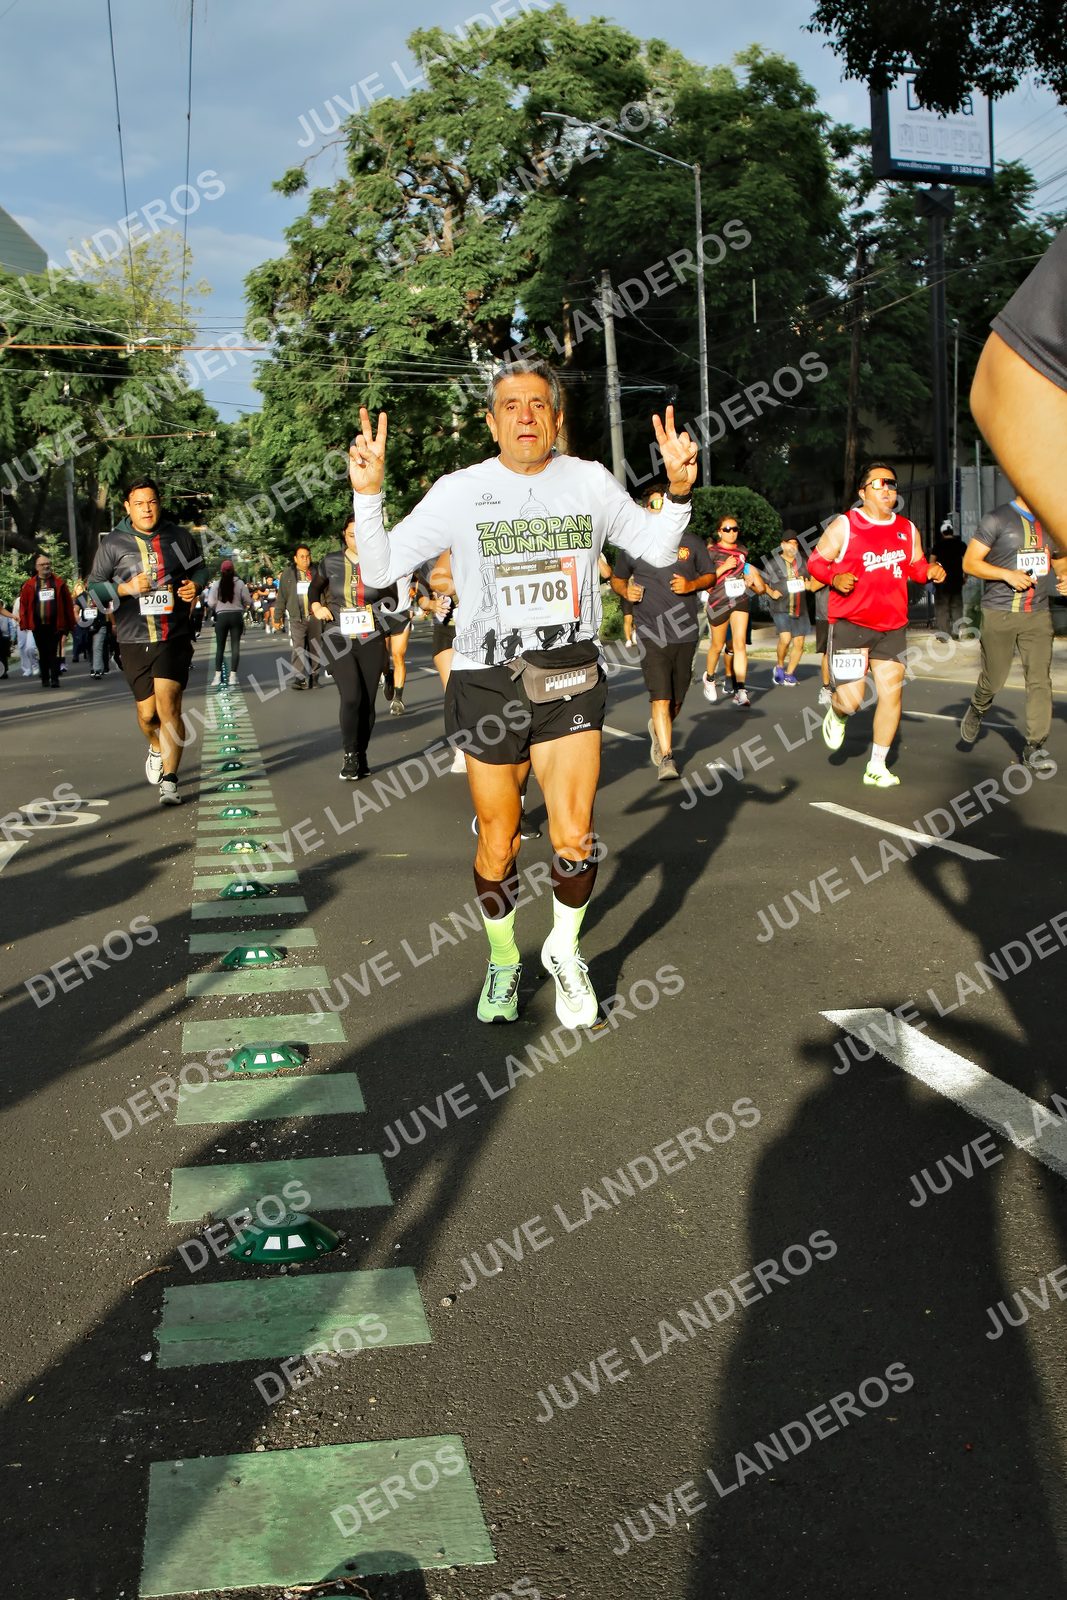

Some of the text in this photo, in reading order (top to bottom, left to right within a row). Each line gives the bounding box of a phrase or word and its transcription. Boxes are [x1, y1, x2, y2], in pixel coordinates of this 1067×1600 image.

[476, 514, 593, 541] ZAPOPAN
[482, 531, 592, 558] RUNNERS
[863, 549, 906, 570] Dodgers
[1019, 556, 1045, 567] 10728
[144, 594, 168, 605] 5708
[501, 580, 568, 606] 11708
[344, 616, 367, 625] 5712
[834, 656, 863, 668] 12871
